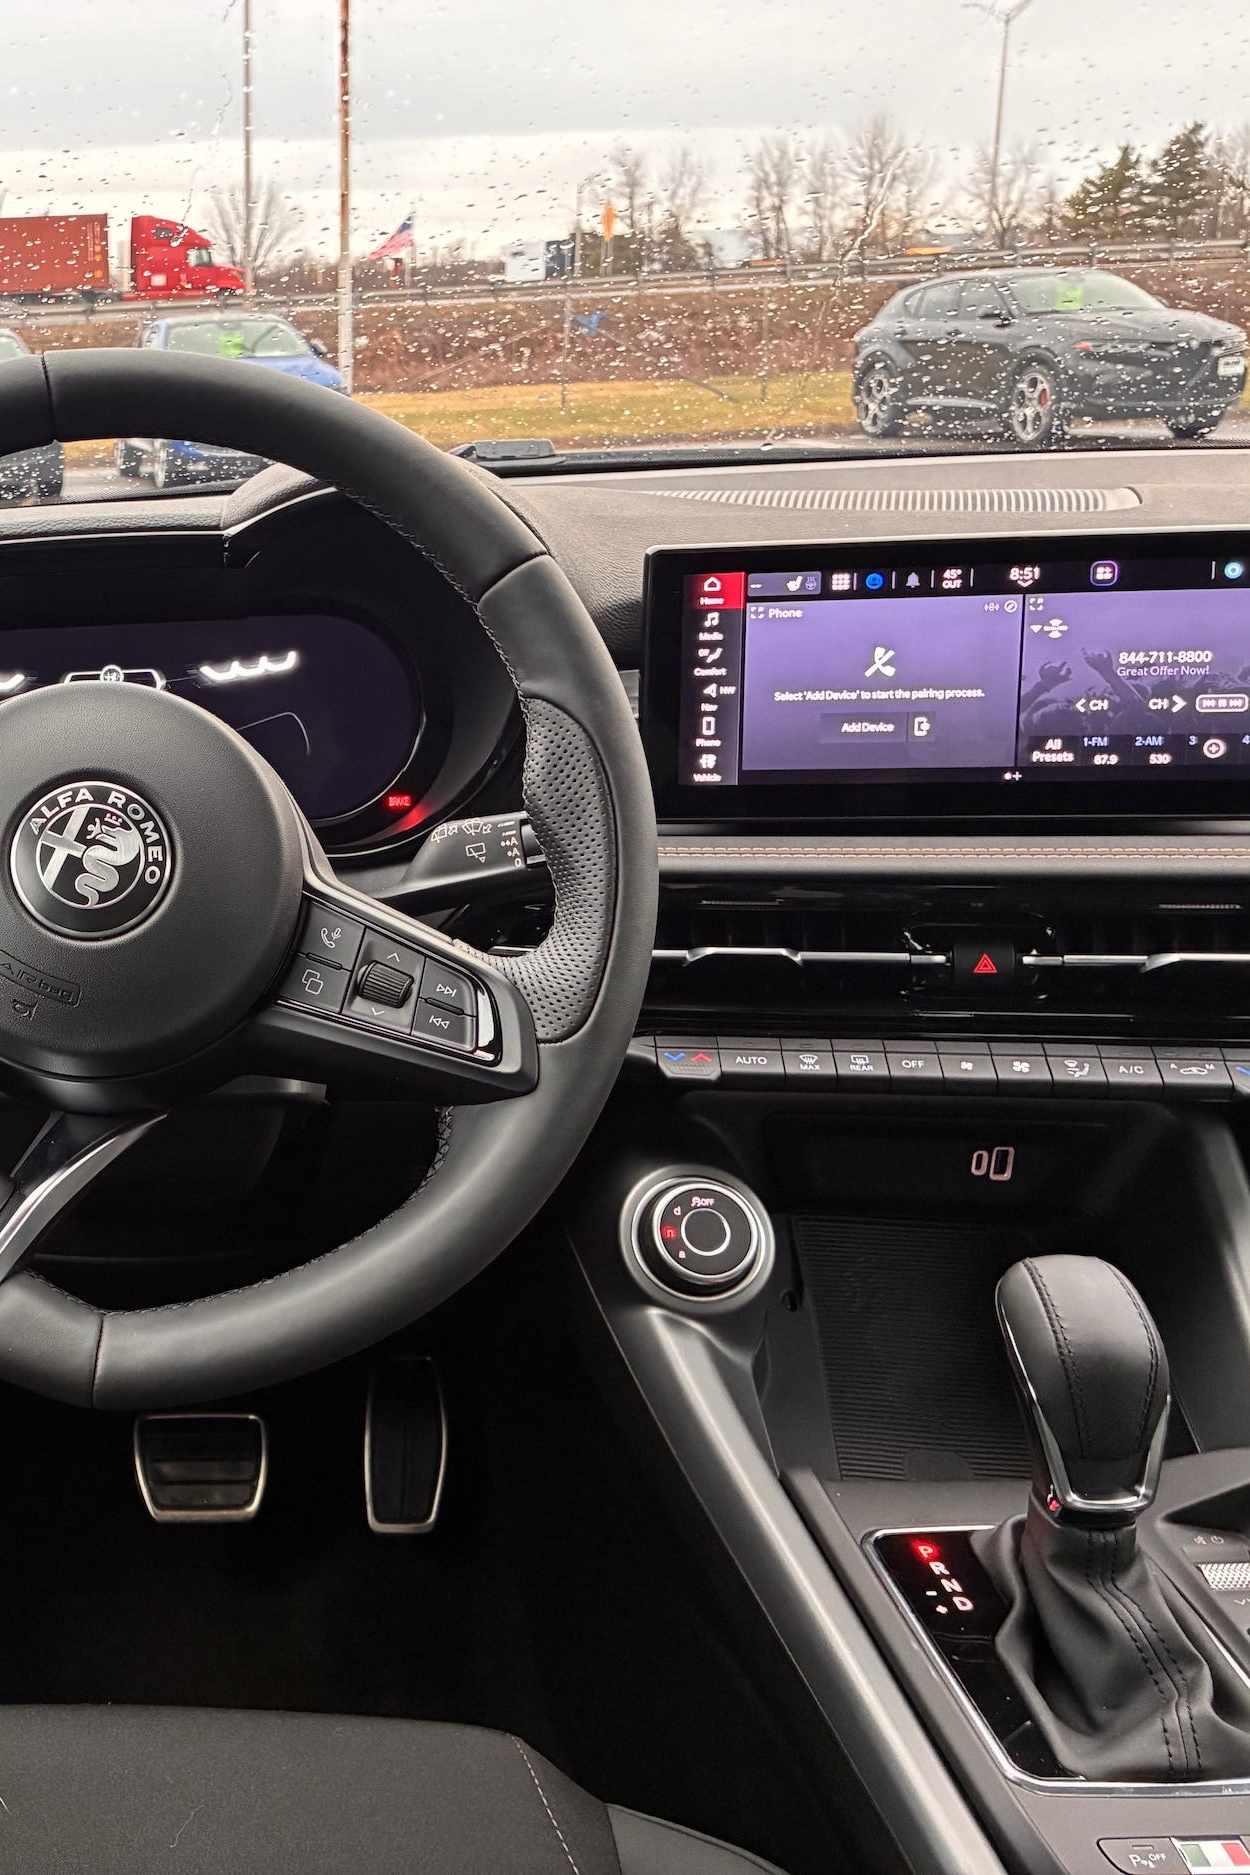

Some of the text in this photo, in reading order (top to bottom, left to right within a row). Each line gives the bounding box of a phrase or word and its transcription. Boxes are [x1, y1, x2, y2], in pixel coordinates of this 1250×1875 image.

[1009, 566, 1040, 580] 8:51
[942, 580, 962, 589] OUT
[700, 597, 725, 605] Home
[768, 608, 803, 618] Phone
[1118, 651, 1212, 664] 844-711-8800
[693, 667, 727, 676] Comfort
[1117, 666, 1210, 676] Great Offer Now!
[774, 691, 802, 701] Select
[860, 690, 871, 700] to
[872, 690, 894, 700] start
[894, 689, 910, 699] the
[911, 688, 944, 700] pairing
[944, 688, 985, 700] process.
[1089, 700, 1108, 710] CH
[1148, 698, 1168, 710] CH
[841, 722, 895, 732] Add Device
[695, 738, 722, 747] Phone
[1045, 738, 1062, 750] All
[1083, 736, 1109, 746] 1-FM
[1134, 736, 1164, 746] 2-AM
[1189, 736, 1198, 745] 3
[1032, 752, 1074, 764] Presets
[1094, 754, 1119, 765] 87.9
[1149, 754, 1172, 764] 530
[693, 773, 722, 782] Vehicle
[388, 796, 411, 806] BRAKE
[29, 788, 164, 885] ALFA ROMEO
[735, 1056, 768, 1066] AUTO
[902, 1060, 924, 1069] OFF
[800, 1063, 820, 1071] MAX
[850, 1064, 874, 1072] REAR
[1118, 1066, 1144, 1074] A/C
[674, 1206, 682, 1216] d
[917, 1545, 934, 1558] P
[929, 1561, 950, 1575] R
[940, 1578, 964, 1592] N
[952, 1596, 974, 1611] D
[1148, 1853, 1166, 1861] OFF
